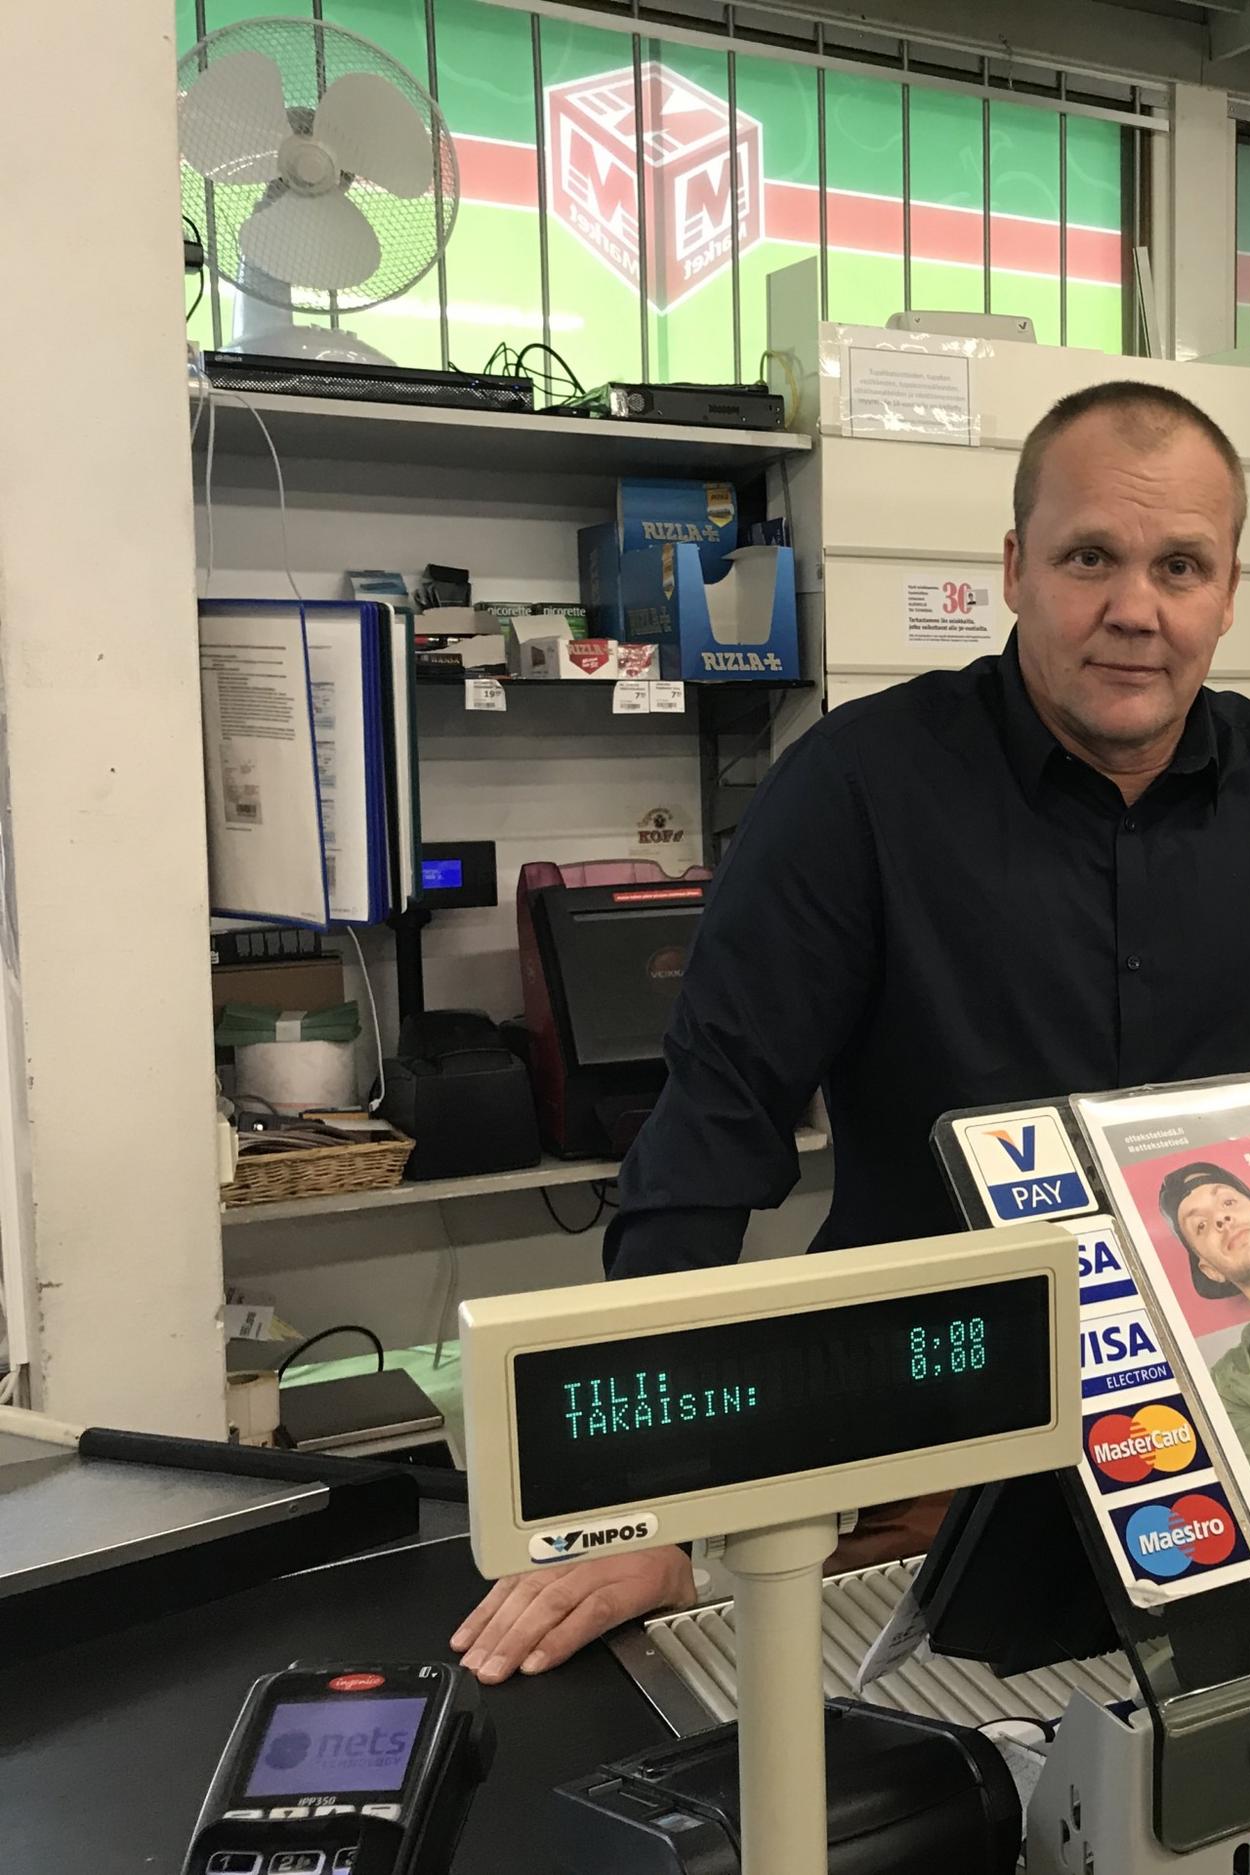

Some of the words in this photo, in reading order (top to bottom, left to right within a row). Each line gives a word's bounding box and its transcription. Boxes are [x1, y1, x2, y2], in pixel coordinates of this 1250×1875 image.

[488, 606, 532, 617] nicorette
[544, 606, 586, 617] nicorette
[981, 1125, 1036, 1173] V
[1011, 1180, 1063, 1211] PAY
[1078, 1240, 1122, 1277] SA
[1080, 1321, 1158, 1368] ISA
[564, 1371, 669, 1411] TILI:
[911, 1317, 985, 1353] 8,00
[1106, 1365, 1168, 1390] ELECTRON
[566, 1386, 758, 1440] TAKAISIN:
[911, 1344, 987, 1381] 0,00
[1093, 1425, 1191, 1464] MasterCard
[543, 1523, 651, 1553] WINPOS
[1139, 1515, 1225, 1556] Maestro
[317, 1726, 409, 1758] nets
